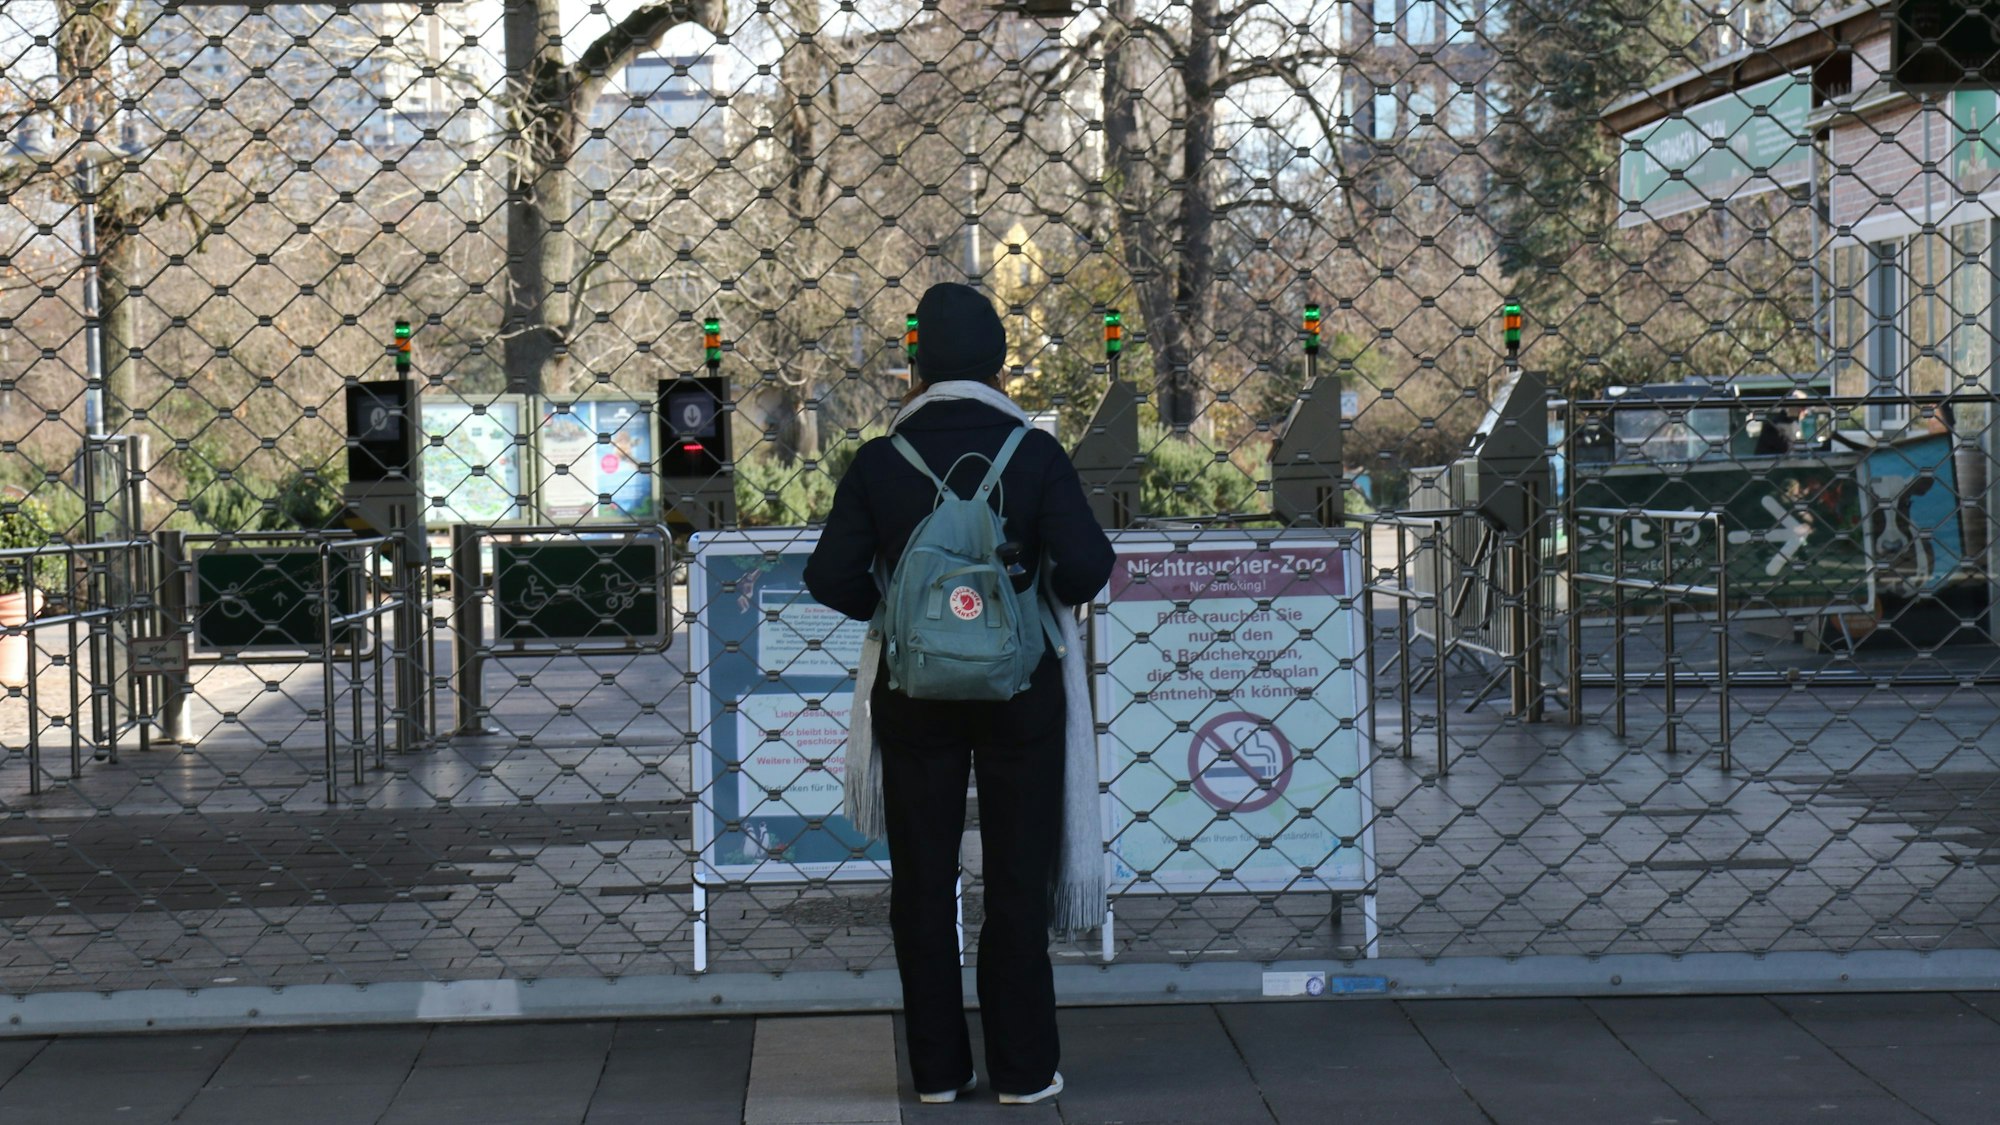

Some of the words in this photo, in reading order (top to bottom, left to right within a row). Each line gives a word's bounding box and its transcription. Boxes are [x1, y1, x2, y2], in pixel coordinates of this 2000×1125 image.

[1127, 555, 1327, 578] Nichtraucher-Zoo
[1190, 581, 1204, 592] No
[1210, 580, 1267, 592] Smoking!
[1157, 611, 1197, 625] Bitte
[1203, 609, 1271, 624] rauchen
[1276, 608, 1303, 621] Sie
[1242, 629, 1273, 641] den
[1162, 650, 1171, 662] 6
[1177, 648, 1303, 663] Raucherzonen,
[1147, 669, 1172, 682] die
[1177, 668, 1204, 681] Sie
[1209, 666, 1245, 680] dem
[1251, 664, 1319, 680] Zooplan
[1150, 686, 1246, 701] entnehen
[802, 709, 849, 718] Besucher
[796, 728, 821, 736] bleibt
[824, 727, 838, 735] bis
[757, 756, 790, 766] Weitere
[811, 783, 824, 792] für
[826, 783, 839, 791] Ihr
